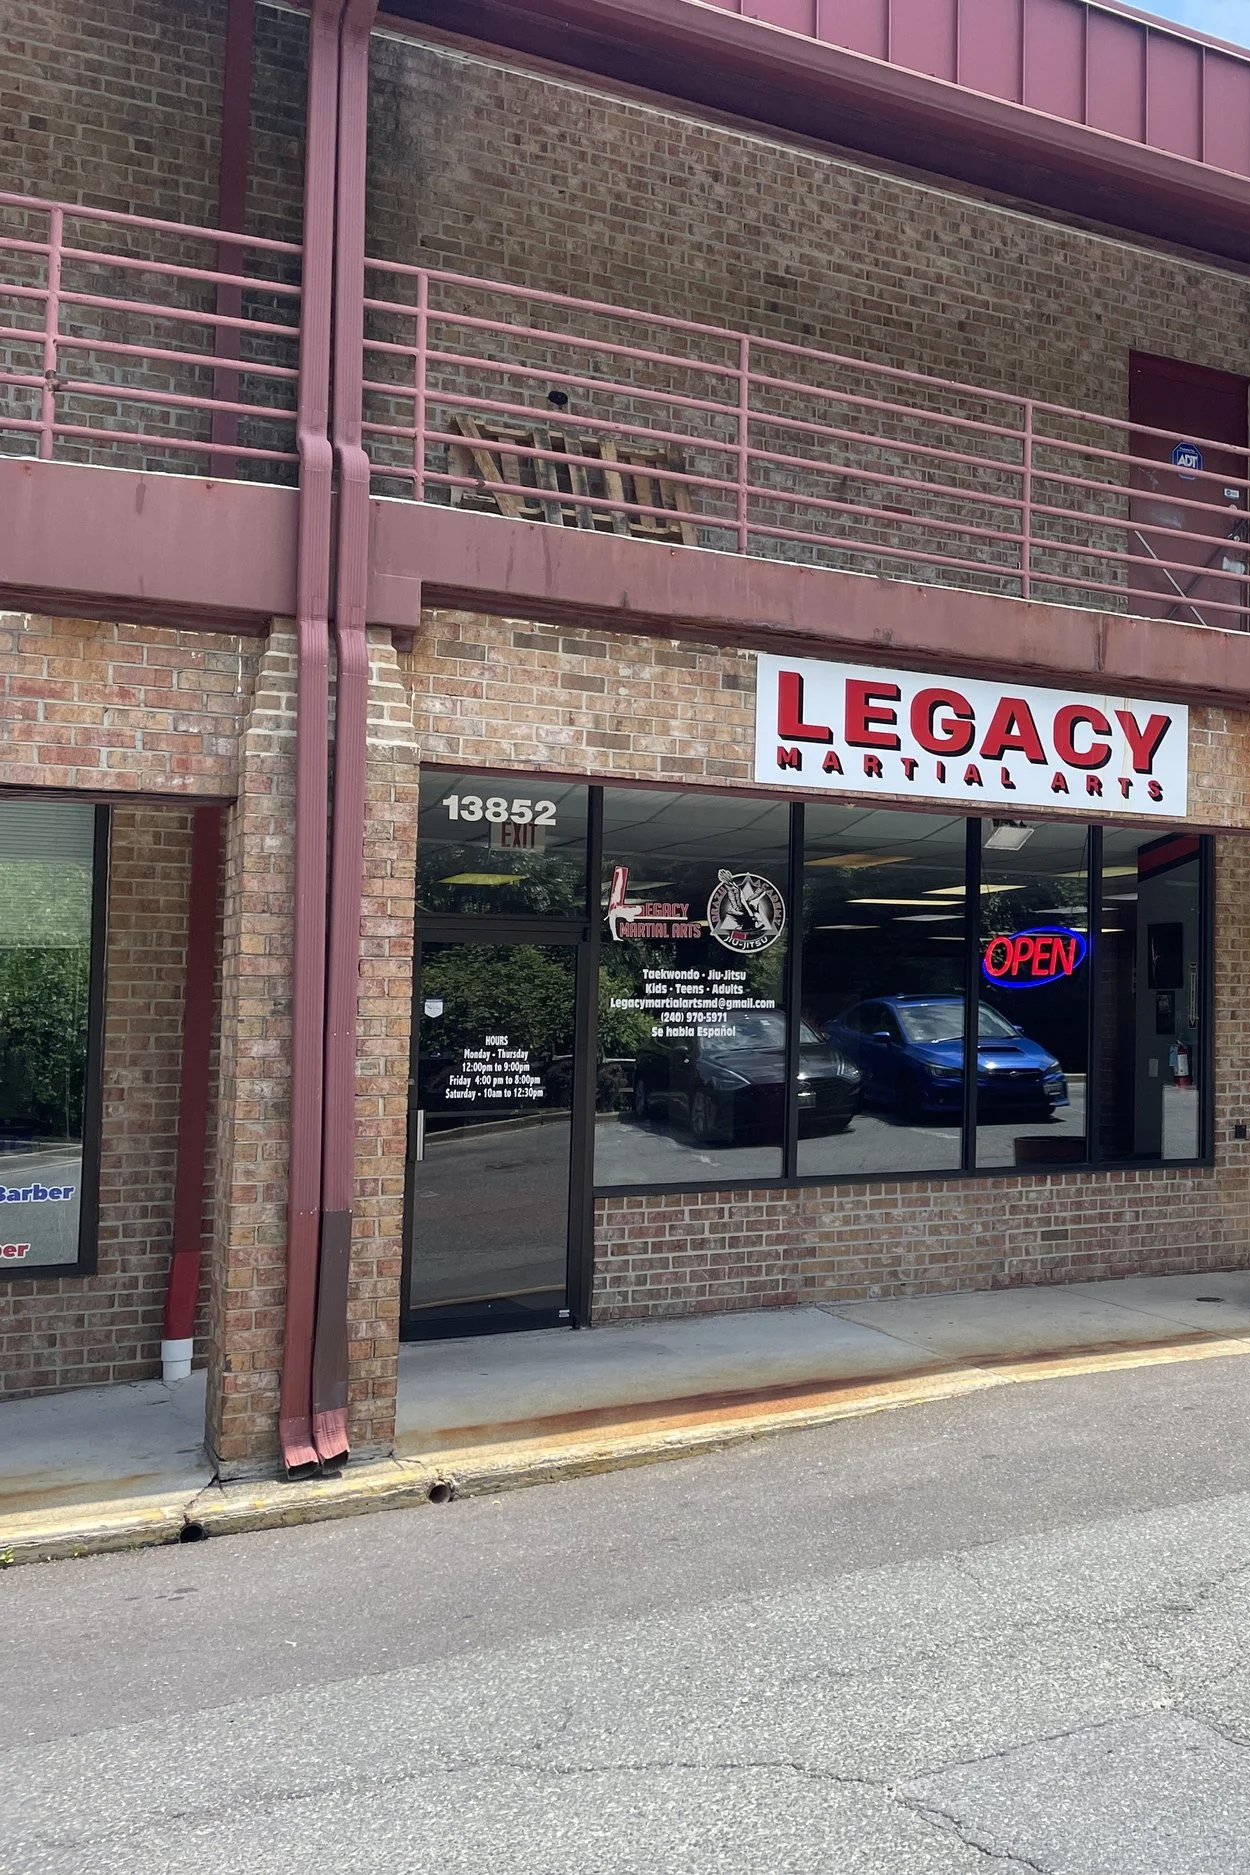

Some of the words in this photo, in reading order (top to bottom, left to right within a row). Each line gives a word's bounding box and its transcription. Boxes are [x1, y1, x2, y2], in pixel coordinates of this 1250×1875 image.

[1177, 454, 1198, 468] ADT
[777, 671, 1172, 774] LEGACY
[777, 746, 1016, 789] MARTIAL
[1051, 771, 1163, 801] ARTS
[442, 795, 557, 826] 13852
[501, 822, 538, 848] EXIT
[754, 880, 781, 925] ACADEMY
[619, 922, 669, 938] MARTIAL
[672, 923, 701, 938] ARTS
[724, 936, 768, 950] JIU-JITSU
[985, 936, 1077, 977] OPEN
[642, 969, 700, 980] Taekwondo
[645, 983, 667, 994] Kids
[675, 984, 704, 994] Teens
[711, 984, 743, 995] Adults
[610, 997, 775, 1010] Legacymartialartsmd@gmail.com
[660, 1012, 684, 1023] (240)
[686, 1012, 727, 1023] 970-5971
[651, 1026, 663, 1037] Se
[665, 1026, 695, 1037] habla
[697, 1026, 736, 1038] Español
[485, 1035, 509, 1046] HOURS
[464, 1049, 491, 1061] Monday
[498, 1049, 529, 1061] Thursday
[462, 1062, 493, 1074] 12:00pm
[494, 1062, 502, 1072] to
[503, 1062, 530, 1074] 9:00pm
[449, 1075, 471, 1087] Friday
[474, 1075, 491, 1085] 4:00
[493, 1077, 504, 1087] pm
[505, 1075, 513, 1085] to
[514, 1075, 541, 1086] 8:00pm
[445, 1088, 476, 1101] Saturday
[484, 1088, 502, 1098] 10am
[504, 1088, 511, 1097] to
[513, 1088, 544, 1100] 12:30pm
[0, 1243, 30, 1259] er
